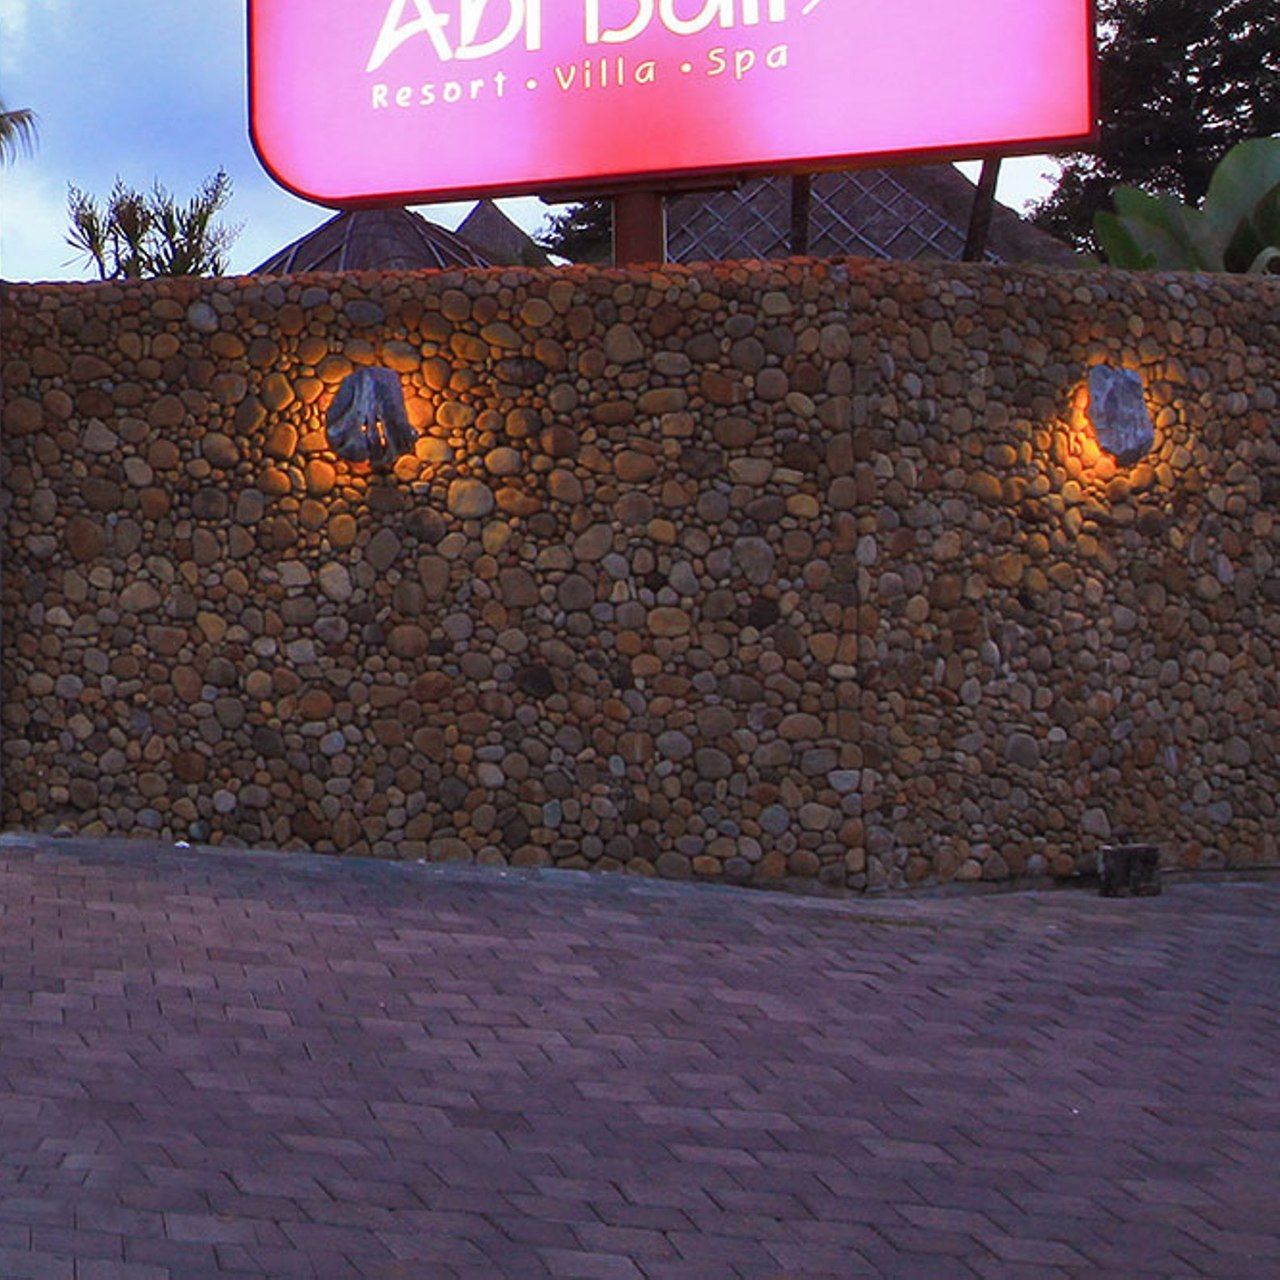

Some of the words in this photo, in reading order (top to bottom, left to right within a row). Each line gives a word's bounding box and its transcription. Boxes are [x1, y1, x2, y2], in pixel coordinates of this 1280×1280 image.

[371, 70, 508, 109] Resort
[553, 56, 658, 92] Villa
[705, 43, 790, 80] Spa
